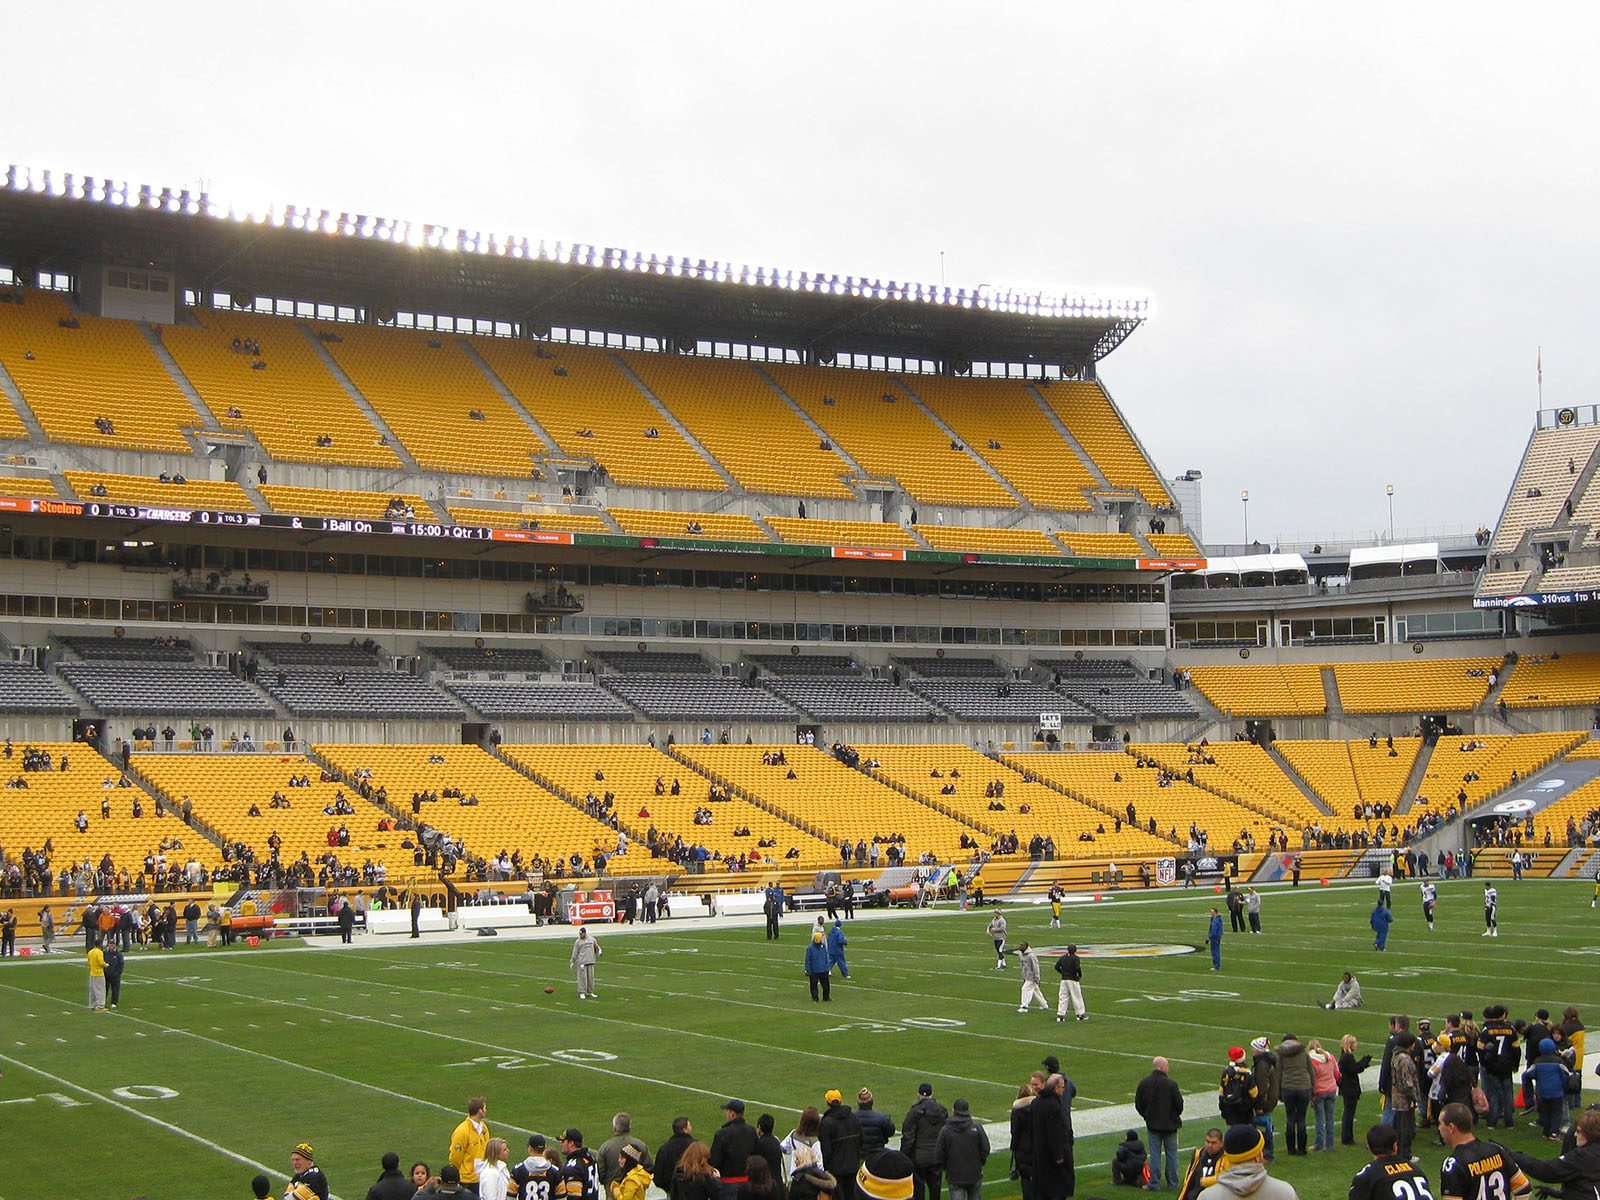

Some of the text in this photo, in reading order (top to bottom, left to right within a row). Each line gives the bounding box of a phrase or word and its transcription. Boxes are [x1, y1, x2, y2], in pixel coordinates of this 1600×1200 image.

[40, 501, 82, 515] Steelers
[91, 504, 100, 515] 0
[129, 508, 136, 516] 3
[147, 509, 192, 521] CHARGERS
[201, 512, 209, 522] 0
[237, 515, 243, 523] 3
[292, 517, 303, 528] &
[330, 520, 352, 531] Ball
[355, 521, 372, 532] On
[410, 525, 441, 537] 15:00
[452, 527, 472, 539] Qtr
[477, 528, 483, 538] 1
[1473, 598, 1508, 608] Manning
[1541, 594, 1570, 603] 310YDS
[1574, 593, 1588, 602] 1TD
[1159, 868, 1173, 880] NFL
[1495, 1035, 1506, 1056] 7
[1384, 1162, 1414, 1175] CLARK
[525, 1180, 551, 1200] 83
[1392, 1176, 1434, 1200] 25
[1475, 1170, 1508, 1200] 43
